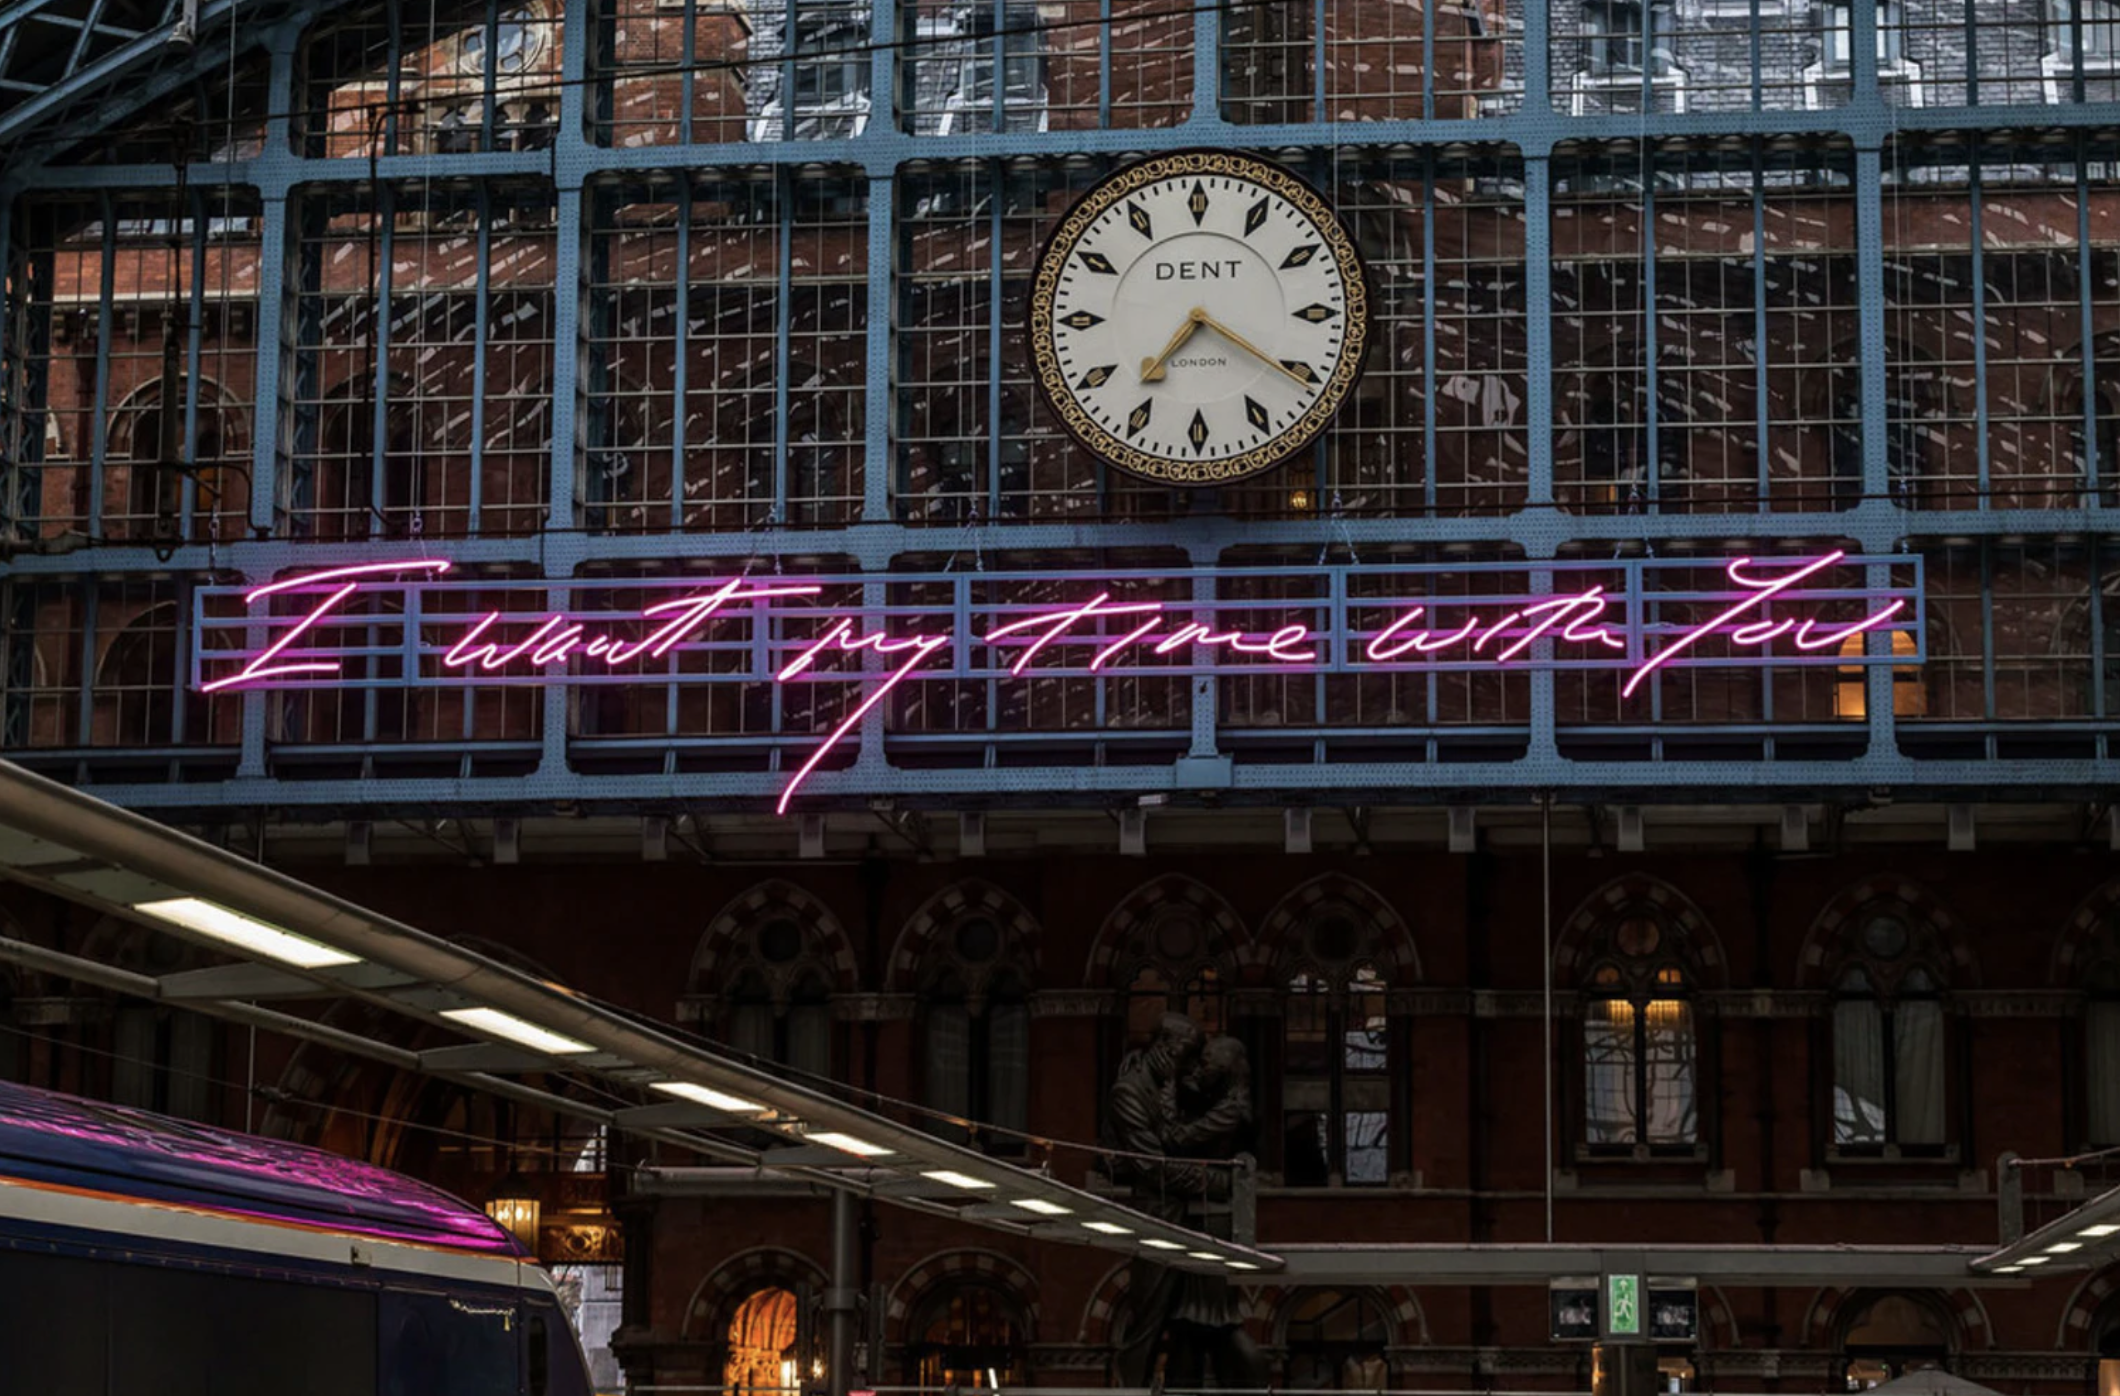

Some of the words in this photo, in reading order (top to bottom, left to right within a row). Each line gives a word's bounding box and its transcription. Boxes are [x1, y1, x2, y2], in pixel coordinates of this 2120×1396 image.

[1155, 260, 1242, 281] DENT
[1170, 358, 1227, 368] LONDON
[201, 559, 450, 692] I
